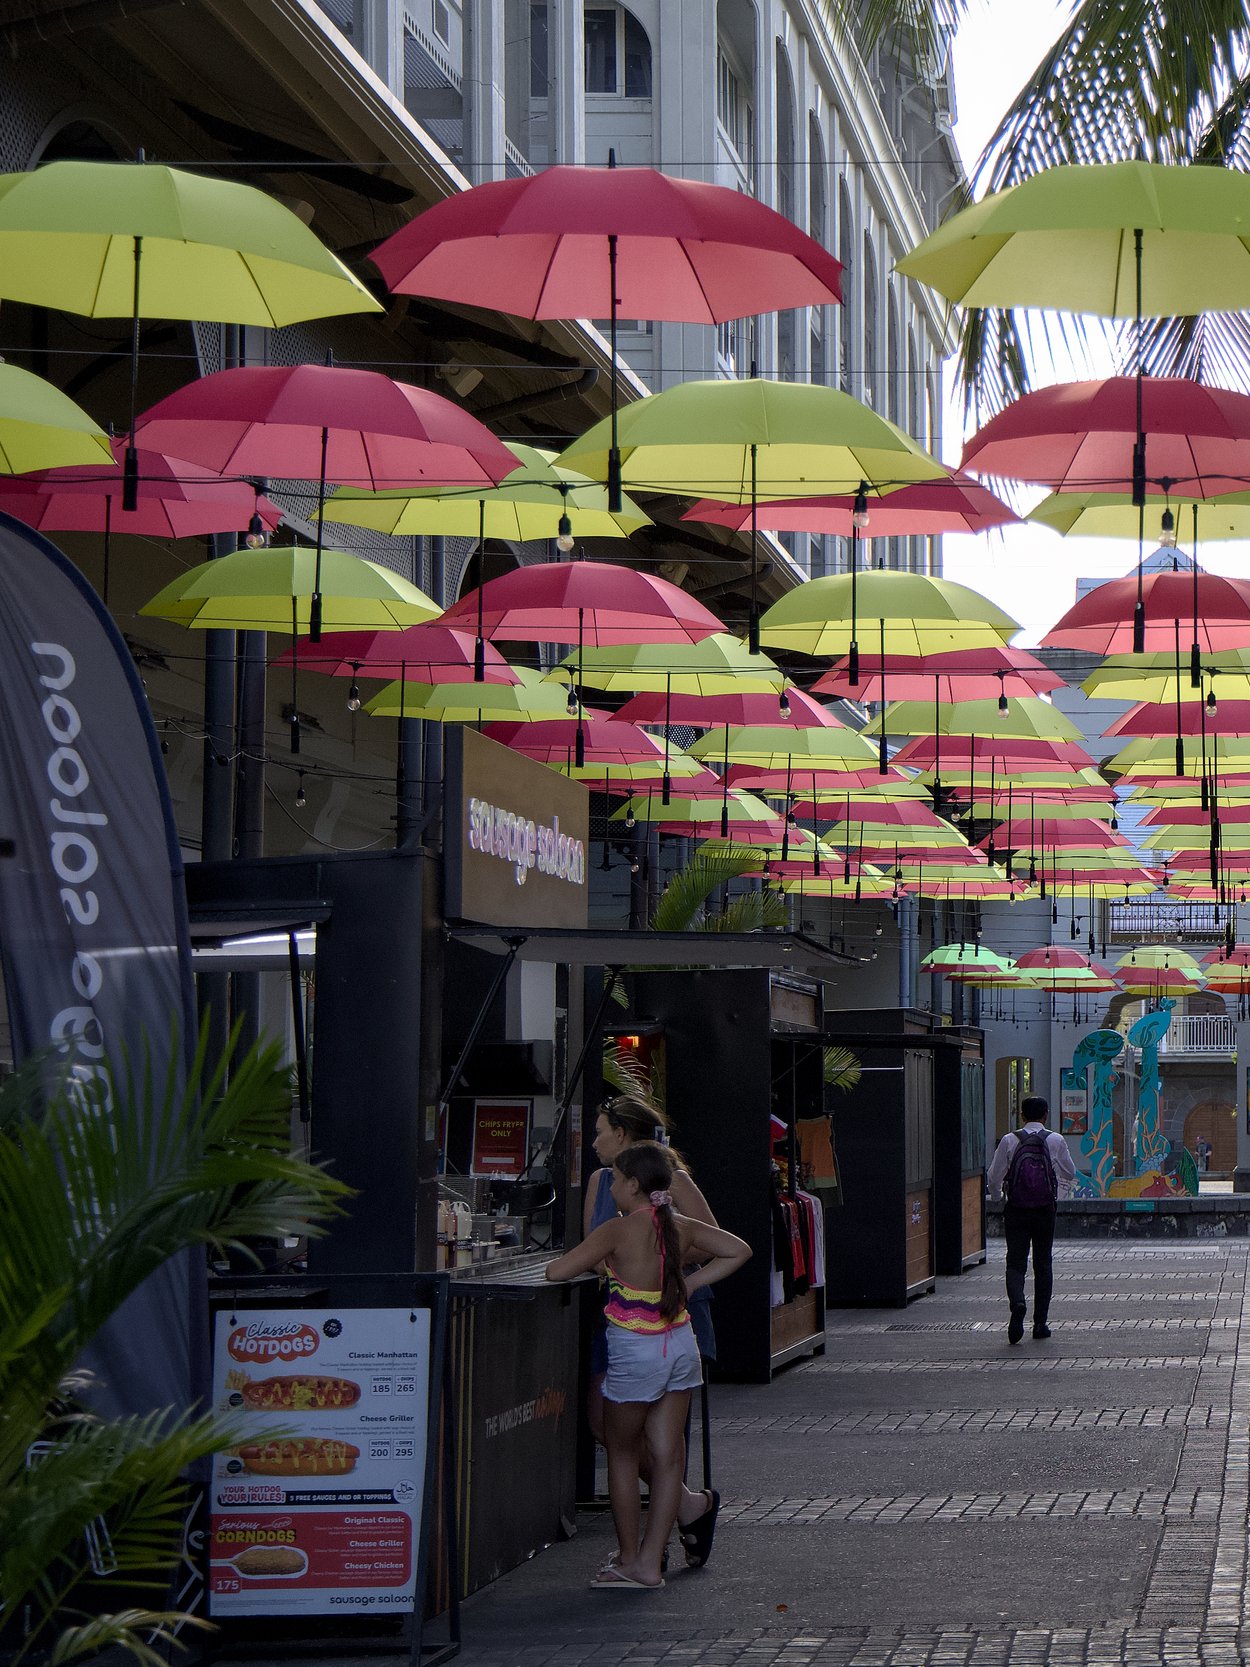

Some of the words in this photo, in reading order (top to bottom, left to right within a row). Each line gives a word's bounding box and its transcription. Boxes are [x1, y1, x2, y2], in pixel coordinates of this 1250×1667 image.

[468, 797, 537, 887] sausage
[537, 815, 585, 886] saloon
[479, 1119, 502, 1128] CHIPS
[490, 1129, 511, 1137] ONLY
[247, 1319, 301, 1338] Classic
[232, 1335, 316, 1355] HOTDOGS
[348, 1351, 376, 1359] Classic
[373, 1384, 390, 1393] 185
[397, 1384, 415, 1392] 265
[360, 1414, 388, 1423] Cheese
[389, 1413, 415, 1422] Griller
[484, 1415, 498, 1439] THE
[522, 1399, 536, 1424] BEST
[370, 1448, 389, 1457] 200
[395, 1447, 413, 1456] 295
[224, 1485, 247, 1493] YOUR
[248, 1485, 281, 1493] HOTDOG
[220, 1493, 248, 1502] YOUR
[249, 1492, 285, 1502] RULES!
[217, 1518, 260, 1531] Serious
[344, 1516, 376, 1525] Original
[215, 1529, 297, 1544] CORNDOGS
[344, 1562, 372, 1570] Cheesy
[373, 1561, 404, 1569] Chicken
[216, 1579, 240, 1590] 175
[329, 1596, 376, 1607] sausage
[378, 1593, 416, 1605] saloon
